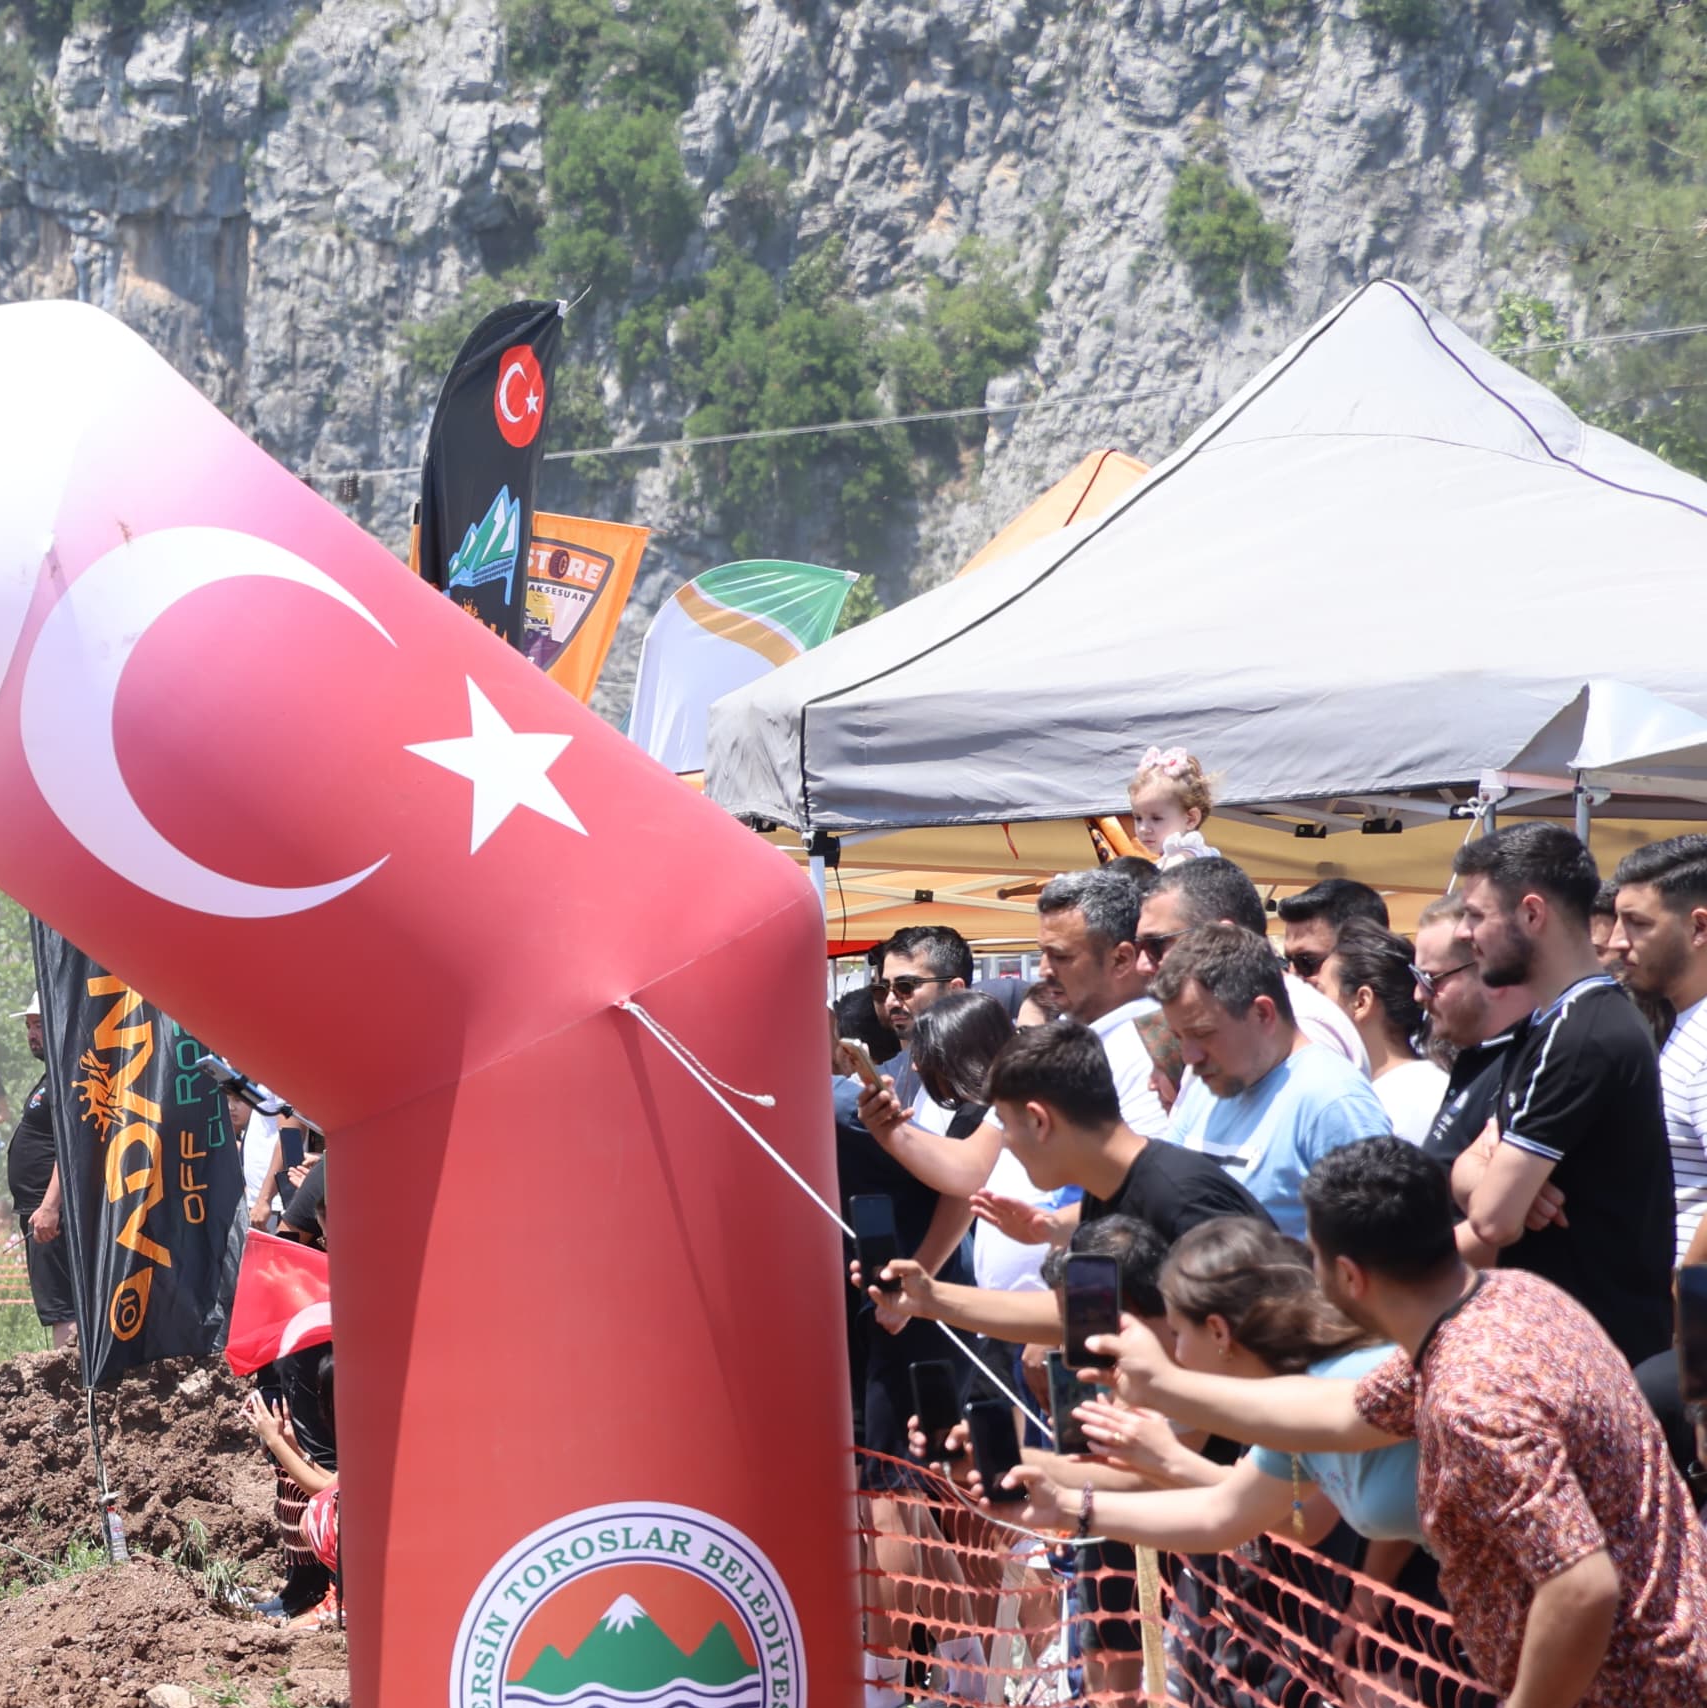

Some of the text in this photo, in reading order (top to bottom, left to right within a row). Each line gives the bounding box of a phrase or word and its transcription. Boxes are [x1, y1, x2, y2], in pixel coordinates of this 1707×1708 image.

[528, 583, 587, 603] AKSESUAR
[87, 975, 172, 1269] ADAN
[180, 1130, 208, 1225] OFF
[503, 1526, 694, 1606] TOROSLAR
